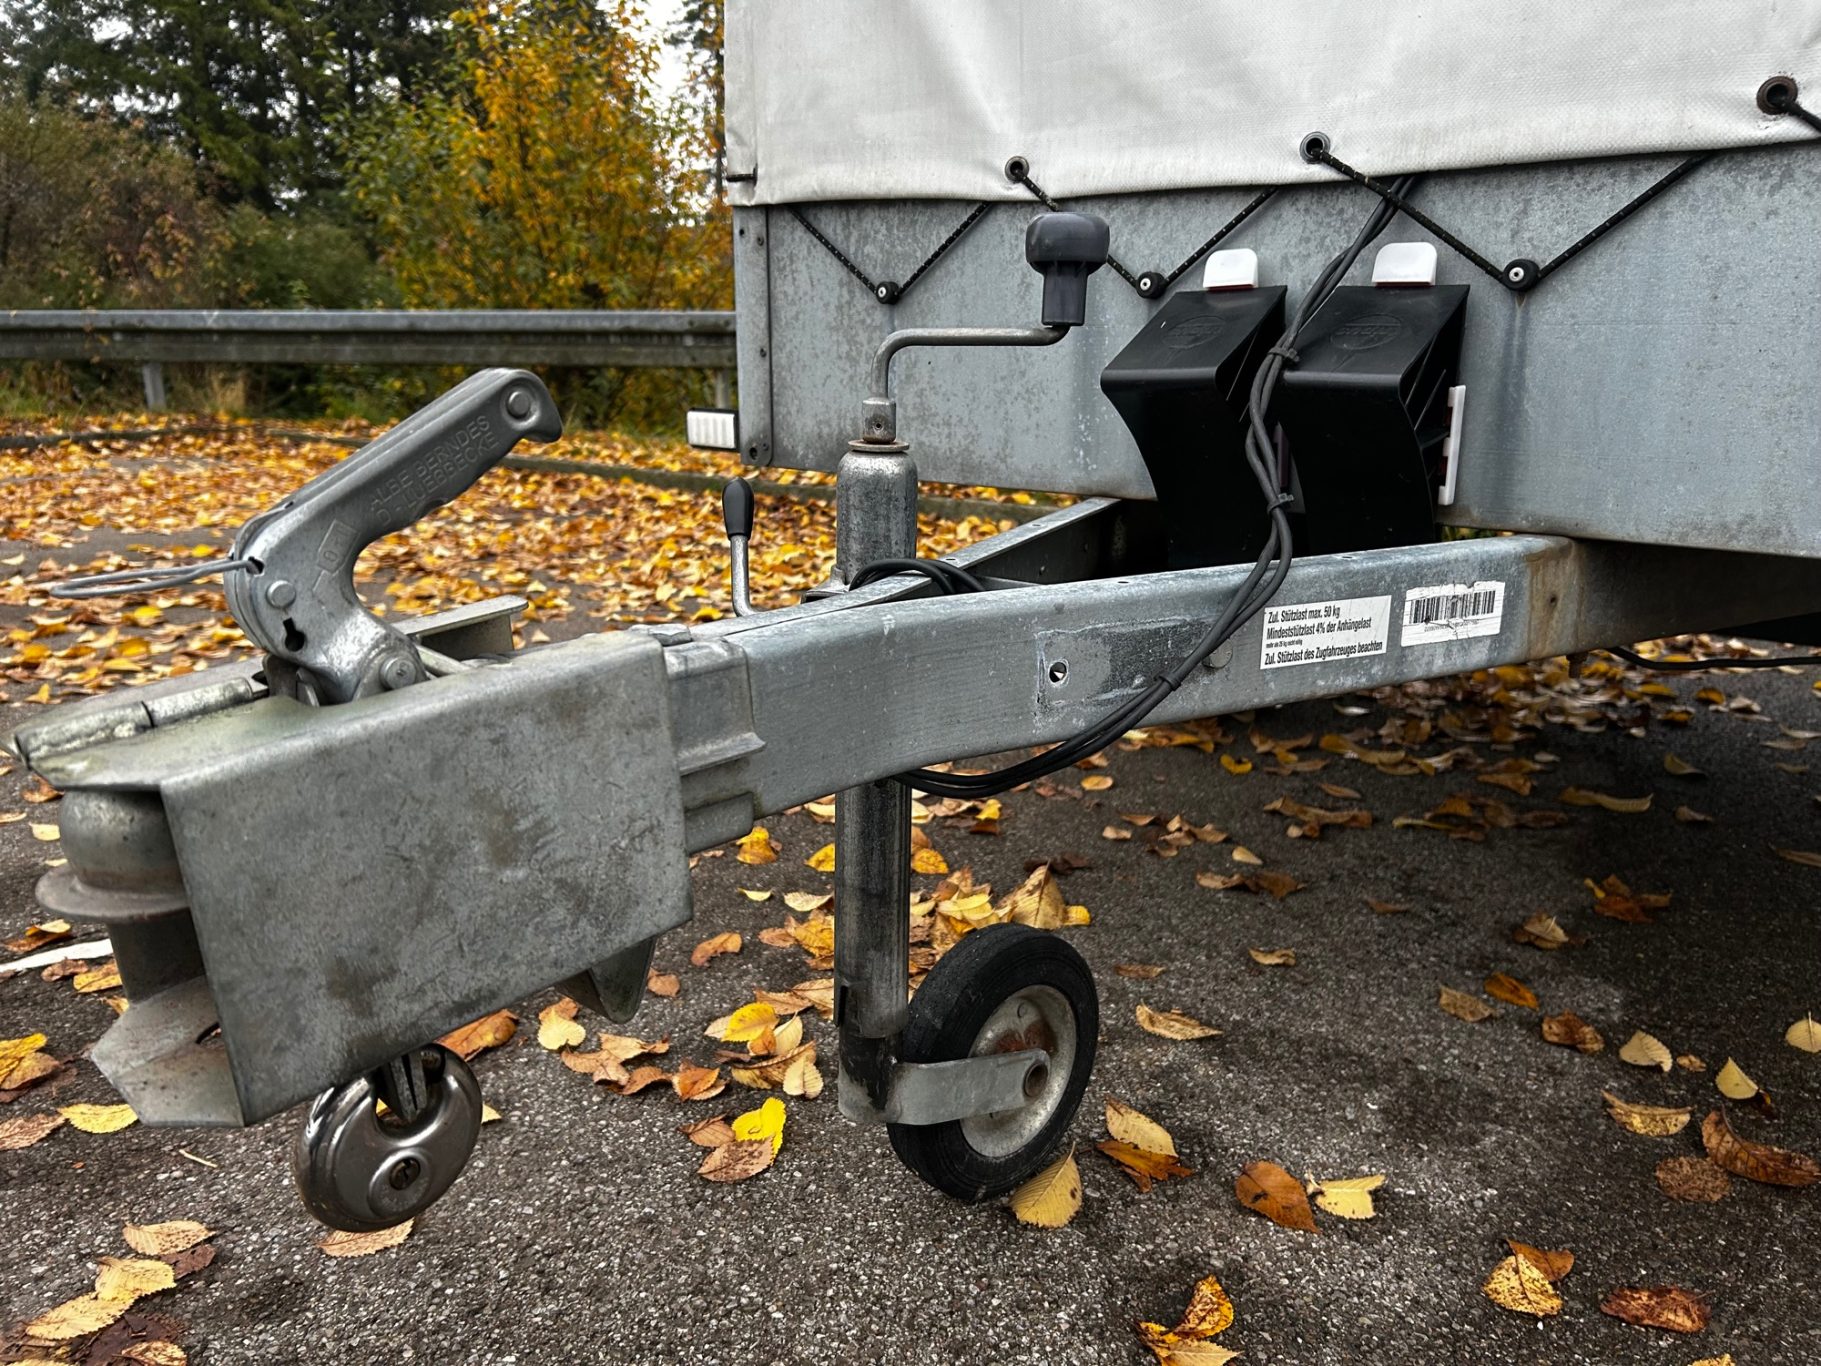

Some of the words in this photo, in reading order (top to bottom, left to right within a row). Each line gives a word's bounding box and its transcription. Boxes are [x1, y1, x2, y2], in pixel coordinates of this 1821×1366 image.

[1268, 611, 1279, 624] Zul.
[1281, 608, 1308, 622] Stützlast
[1308, 609, 1322, 619] max.
[1323, 605, 1332, 617] 50
[1332, 604, 1341, 619] kg
[1266, 623, 1315, 640] Mindeststützlast
[1315, 621, 1325, 634] 4%
[1326, 620, 1336, 633] der
[1336, 616, 1372, 633] Anhängelast
[1264, 652, 1275, 665] Zul.
[1277, 648, 1303, 664] Stützlast
[1303, 647, 1315, 660] des
[1315, 644, 1356, 661] Zugfahrzeuges
[1357, 640, 1383, 654] beachten
